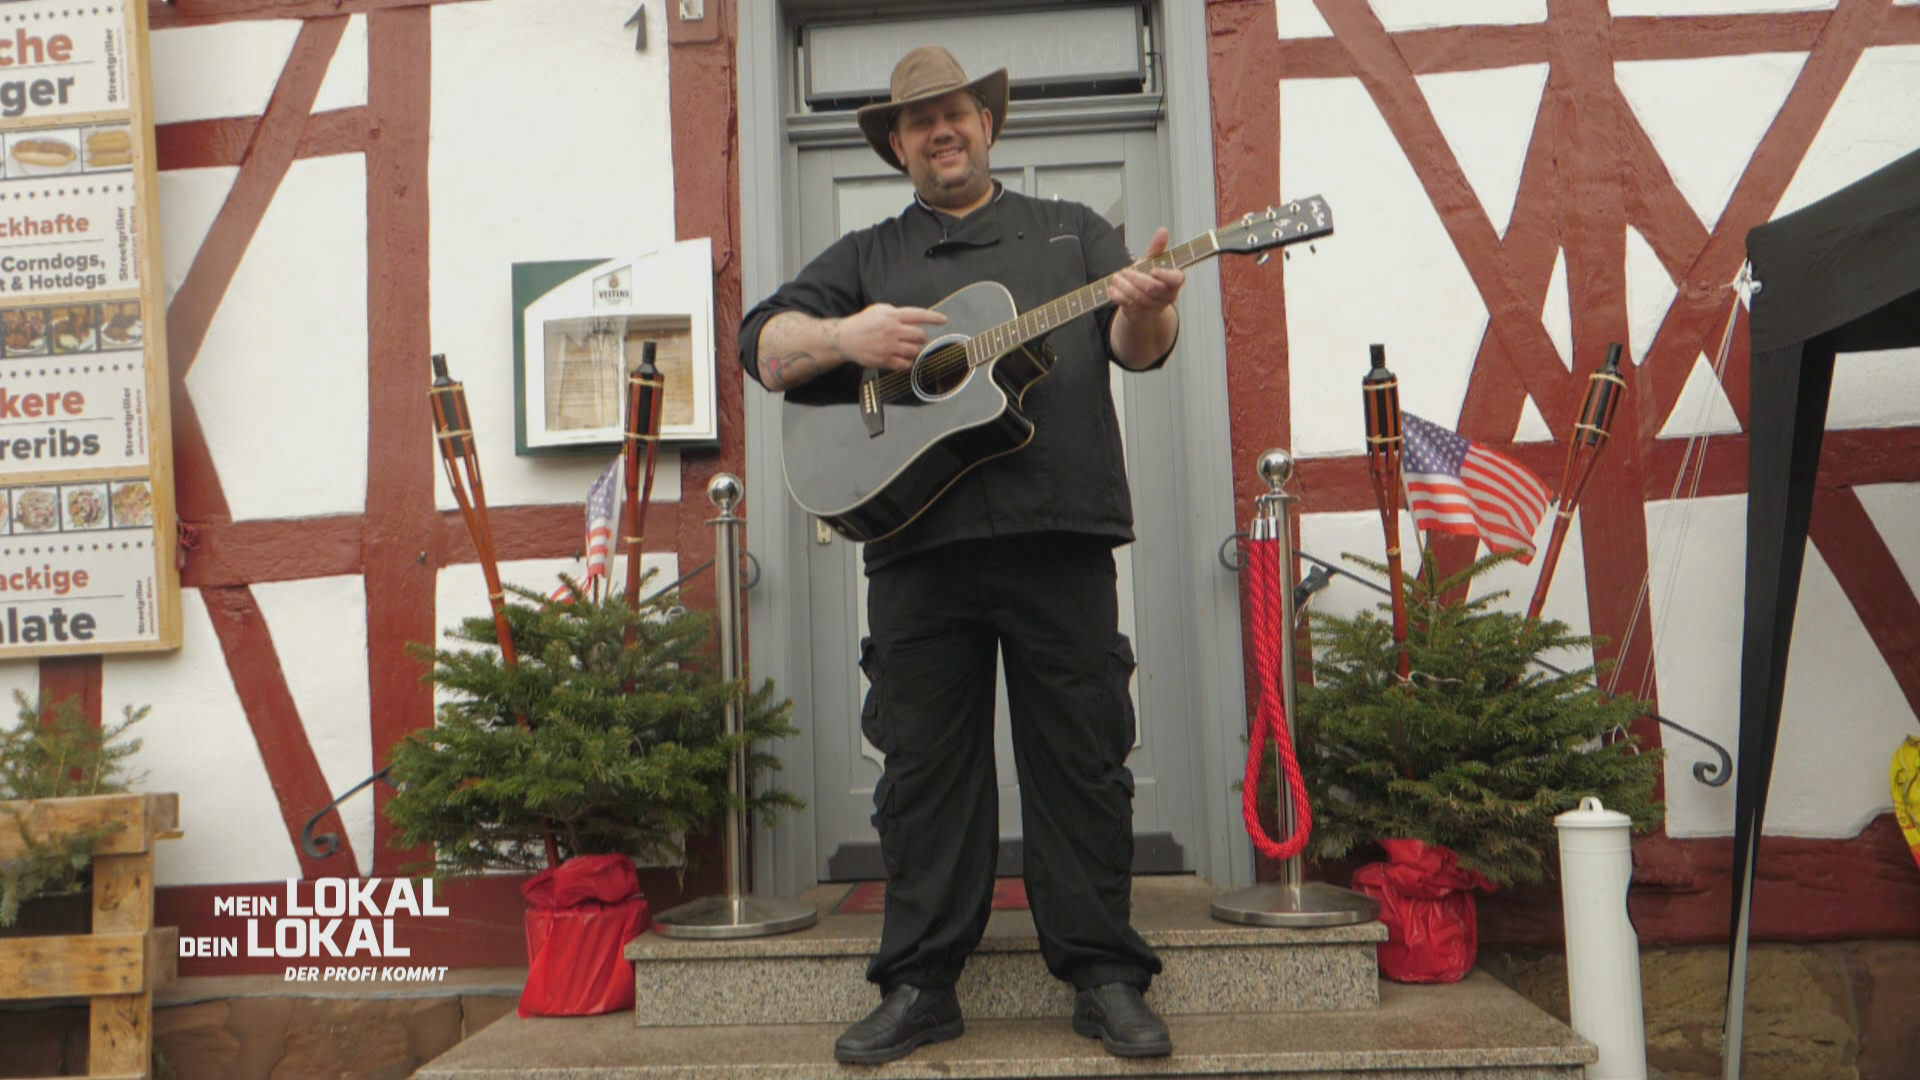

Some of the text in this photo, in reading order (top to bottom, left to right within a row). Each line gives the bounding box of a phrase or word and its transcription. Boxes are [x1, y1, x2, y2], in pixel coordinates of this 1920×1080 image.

[624, 2, 647, 51] 1
[105, 28, 117, 103] Streetgriller
[1, 77, 74, 117] ger
[0, 212, 89, 238] ckhafte
[117, 206, 128, 282] Streetgriller
[1, 252, 105, 273] Corndogs,
[11, 275, 23, 291] &
[29, 272, 107, 290] Hotdogs
[0, 387, 85, 419] kere
[124, 387, 135, 457] Streetgriller
[0, 427, 100, 460] reribs
[0, 606, 96, 643] late
[137, 580, 145, 635] Streetgriller
